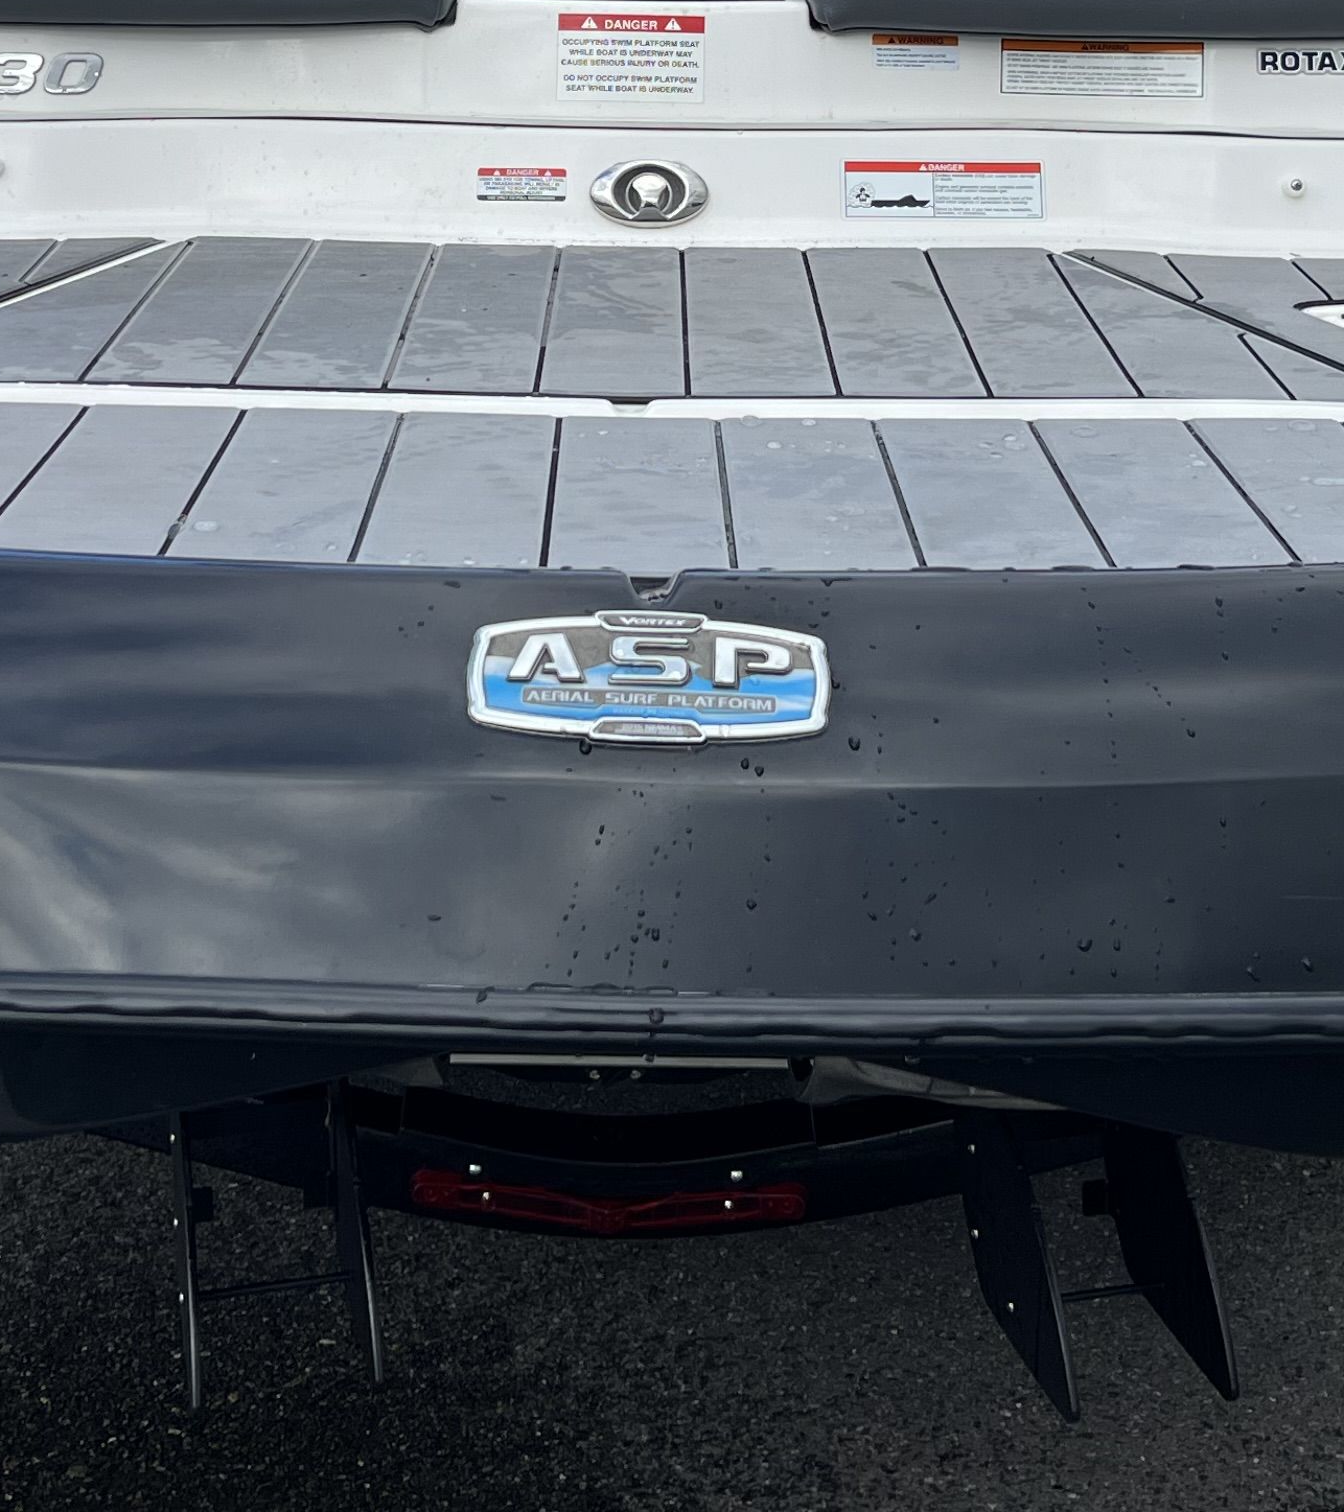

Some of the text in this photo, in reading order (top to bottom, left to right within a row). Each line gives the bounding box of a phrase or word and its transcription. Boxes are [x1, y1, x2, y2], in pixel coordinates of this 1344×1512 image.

[604, 19, 658, 31] DANGER
[611, 39, 632, 47] SWIM
[634, 39, 678, 47] PLATFORM
[679, 40, 700, 48] SEAT
[897, 36, 944, 45] WARNING
[676, 50, 693, 58] MAY
[658, 60, 669, 68] OR
[596, 74, 629, 82] OCCUPY
[566, 84, 586, 92] SEAT
[506, 168, 540, 176] DANGER
[928, 163, 965, 172] DANGER
[619, 616, 687, 627] VORTEX
[527, 690, 594, 704] AERIAL
[605, 691, 656, 705] SURF
[668, 694, 774, 712] PLATFORM
